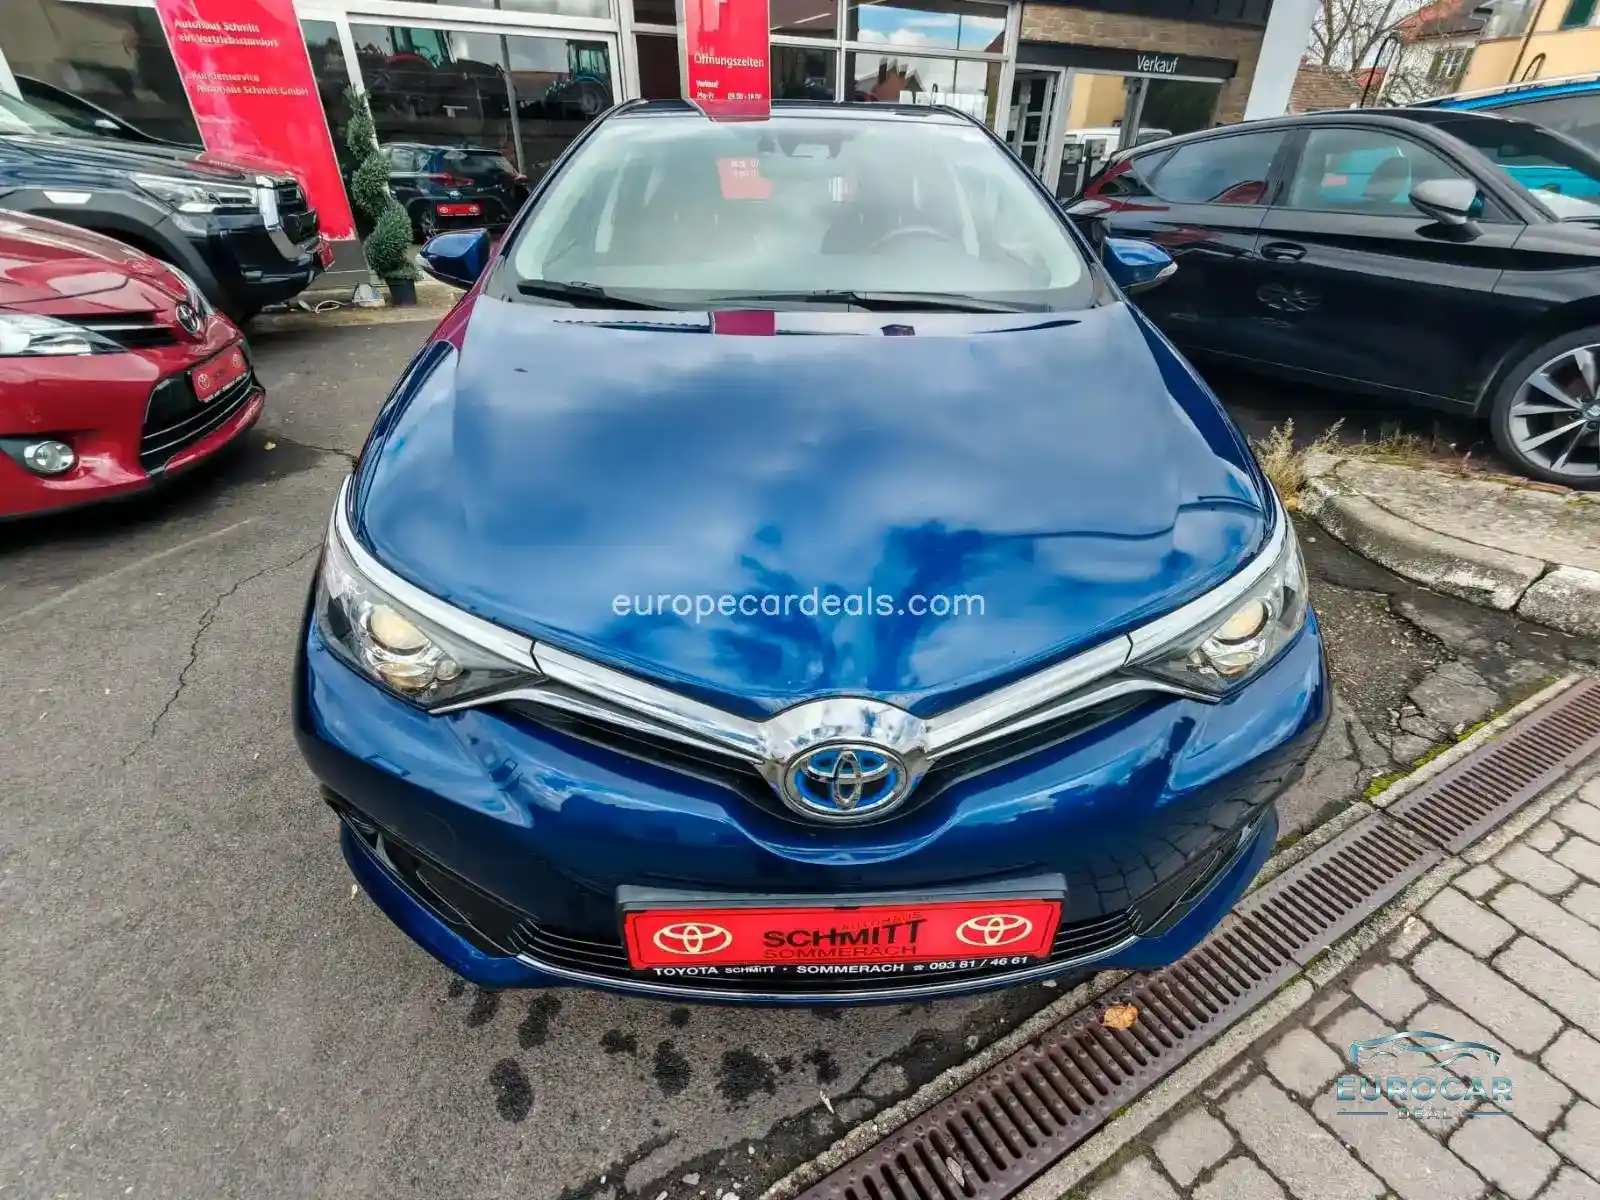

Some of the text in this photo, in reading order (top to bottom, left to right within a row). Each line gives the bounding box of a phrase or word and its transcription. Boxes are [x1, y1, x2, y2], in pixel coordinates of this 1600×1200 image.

[1137, 54, 1179, 73] Verkauf
[762, 918, 927, 948] SCHMITT
[763, 946, 917, 960] SOMMERACH
[653, 966, 719, 977] TOYOTA
[724, 965, 776, 974] SCHMITT
[796, 963, 905, 975] SOMMERACH
[929, 960, 956, 971] 093
[959, 959, 976, 969] 81
[1011, 955, 1029, 965] 61
